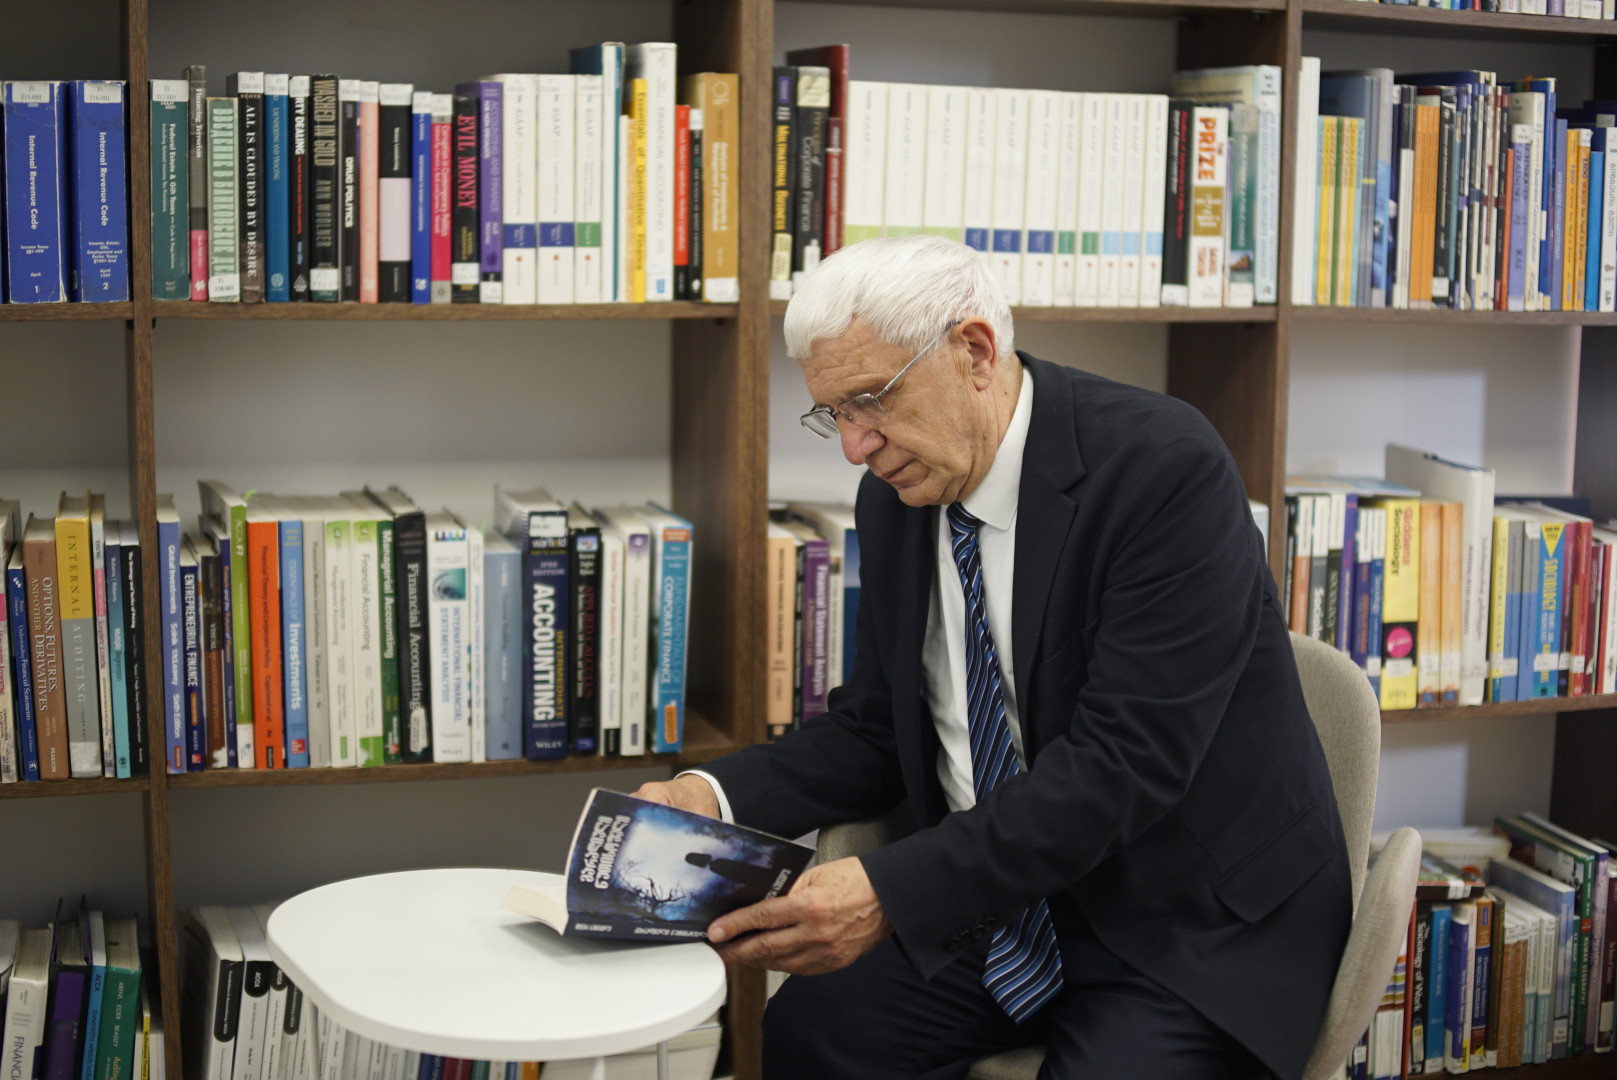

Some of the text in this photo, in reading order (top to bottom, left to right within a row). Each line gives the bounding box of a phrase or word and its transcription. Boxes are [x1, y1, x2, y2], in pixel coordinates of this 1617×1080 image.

[194, 88, 203, 158] Financing Terrorism
[246, 105, 256, 128] ALL
[246, 132, 256, 144] IS
[295, 97, 304, 114] RTY
[295, 116, 305, 155] DEALING
[313, 79, 336, 166] WASHED IN GOLD
[440, 125, 449, 160] Corruption
[457, 115, 476, 209] EVIL MONEY
[490, 100, 499, 212] ACCOUNTING AND FINANCE
[656, 107, 666, 231] FINANCIAL ACCOUNTING
[1198, 116, 1218, 181] PRIZE
[28, 135, 38, 229] Internal Revenue Code
[99, 132, 109, 226] Internal Revenue Code
[246, 148, 256, 207] CLOUDED
[345, 157, 354, 228] DRUG POLITICS
[440, 168, 449, 212] Contemporary
[634, 92, 646, 271] Essentials of Quantitative Finance
[775, 125, 790, 230] MULTINATIONAL BUSINESS
[800, 137, 812, 231] Corporate Finance
[246, 211, 256, 227] BY
[315, 179, 332, 247] ANN WOOLNER
[441, 213, 449, 237] Politics
[1531, 168, 1541, 264] Business Communication
[35, 285, 38, 293] 1
[103, 282, 108, 290] 2
[247, 232, 257, 277] DESIRE
[167, 545, 176, 569] Global
[235, 520, 244, 556] ACCA F7
[532, 538, 566, 548] warfield
[1391, 508, 1403, 576] Sociology
[1402, 507, 1413, 566] Giddens
[67, 535, 86, 703] INTERNAL AUDITING
[168, 570, 178, 614] Investments
[360, 554, 372, 650] Financial Accounting
[381, 530, 395, 659] Managerial Accounting
[1542, 558, 1558, 611] SOCIOLOGY
[31, 577, 48, 711] AND OTHER DERIVATIVES
[41, 577, 57, 692] OPTIONS, FUTURES,
[170, 623, 179, 646] Solnik
[184, 574, 198, 687] ENTREPRENEURIAL FINANCE
[288, 560, 302, 710] ESSENTIALS OF Investments
[406, 562, 422, 710] Financial Accounting
[439, 607, 451, 703] STATEMENT ANALYSIS
[532, 583, 556, 721] ACCOUNTING
[584, 585, 595, 698] APPLIED CALCULUS
[661, 576, 673, 684] CORPORATE FINANCE
[672, 576, 684, 683] FUNDAMENTALS OF
[813, 565, 828, 695] Financial Statement Analysis
[170, 649, 179, 686] McLeavey
[451, 607, 463, 723] INTERNATIONAL FINANCIAL
[555, 630, 565, 719] INTERMEDIATE
[173, 694, 182, 712] Sixth
[174, 713, 182, 738] Edition
[49, 747, 57, 773] PEARSON
[536, 740, 562, 749] WILEY
[93, 974, 101, 992] ACCA
[1414, 921, 1427, 1013] Sociology of Work
[112, 1025, 120, 1047] BEASLEY
